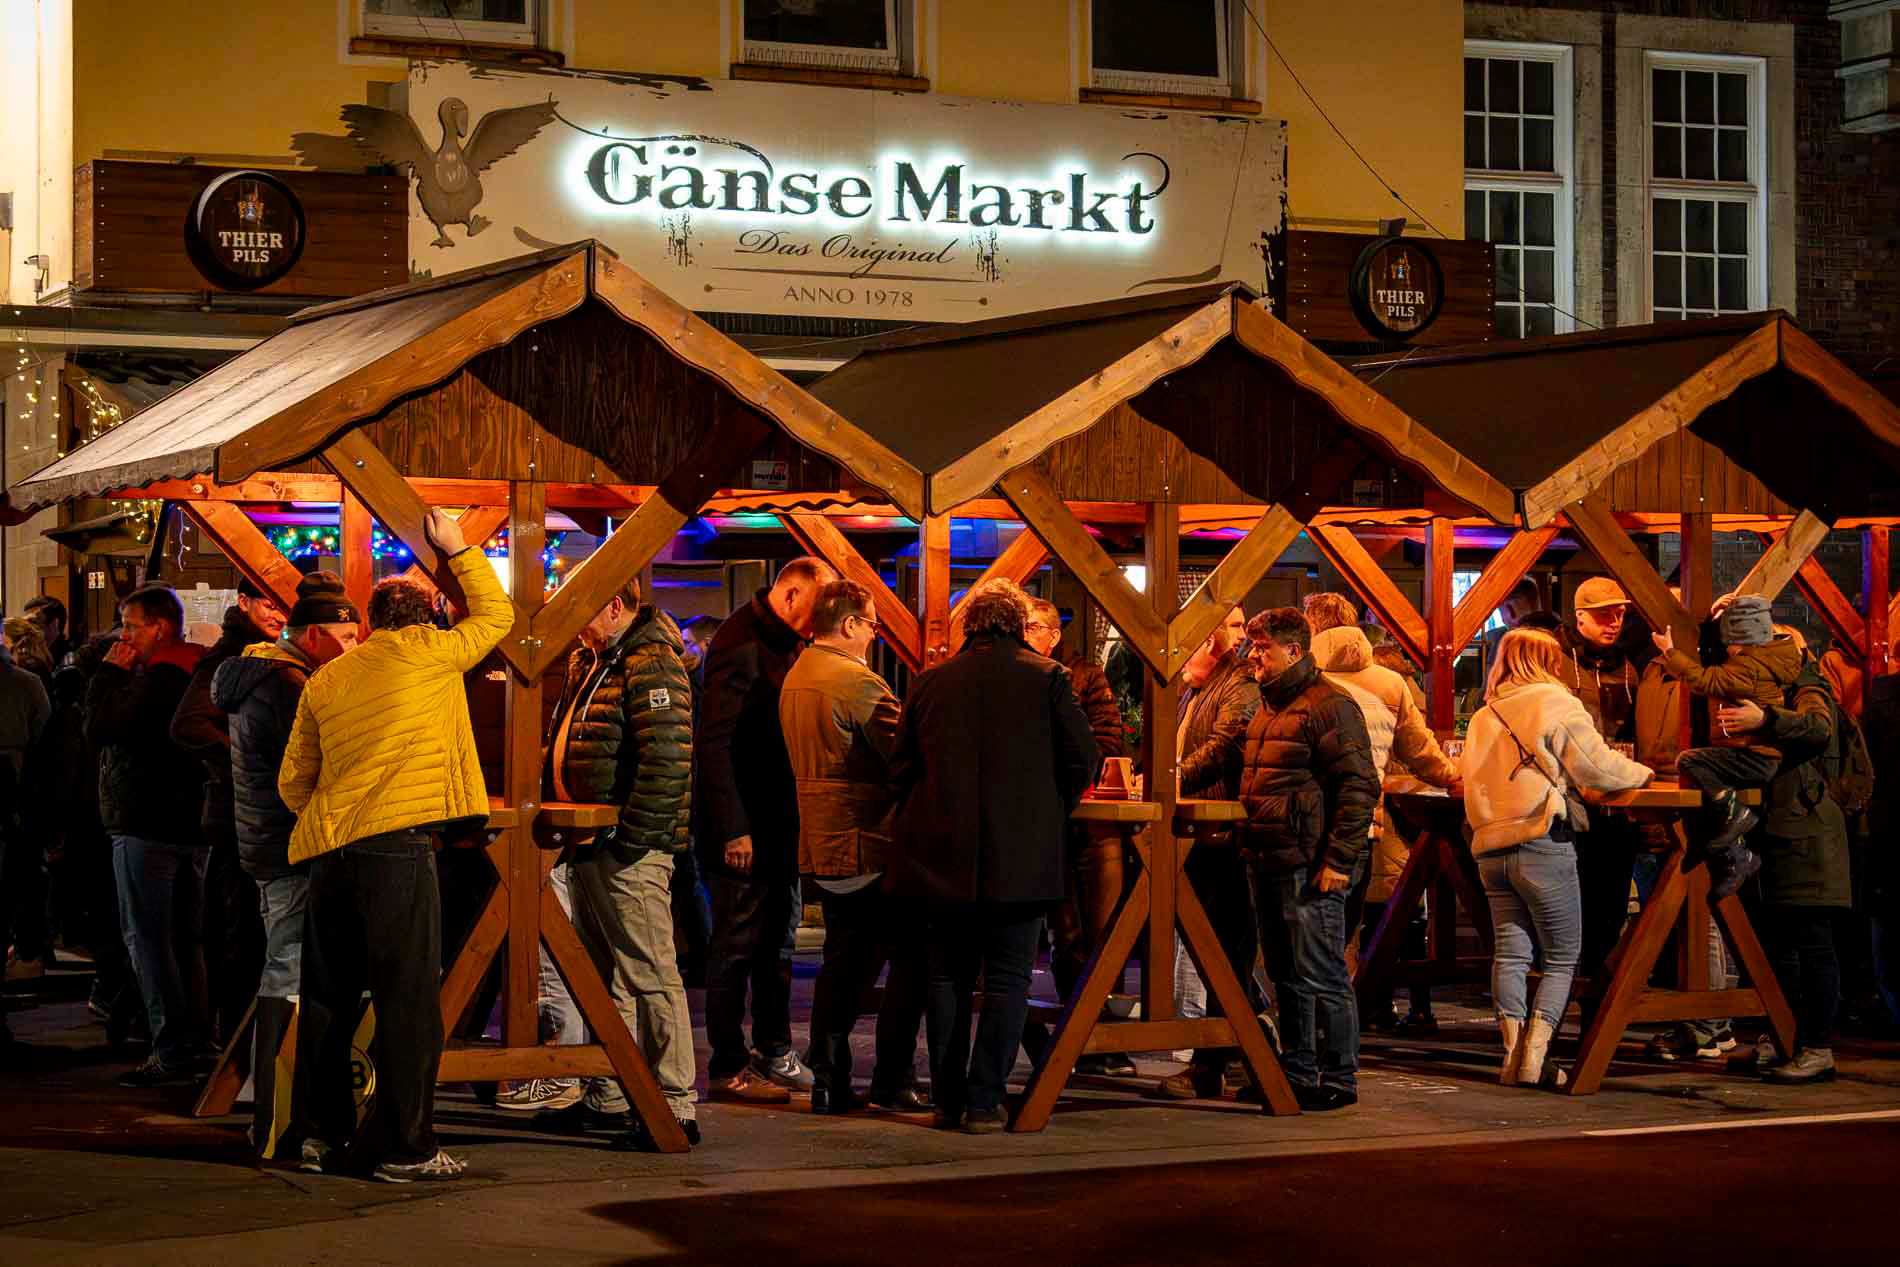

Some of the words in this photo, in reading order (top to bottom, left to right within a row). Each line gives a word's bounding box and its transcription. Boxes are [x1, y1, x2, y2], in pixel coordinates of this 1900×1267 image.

[584, 141, 874, 218] Gänse
[887, 157, 1164, 234] Markt
[218, 231, 284, 249] THIER
[232, 249, 271, 263] PILS
[734, 229, 812, 256] Das
[821, 233, 959, 280] Original
[783, 286, 855, 305] ANNO
[866, 289, 914, 308] 1978
[1375, 288, 1425, 305] THIER
[1386, 305, 1416, 318] PILS
